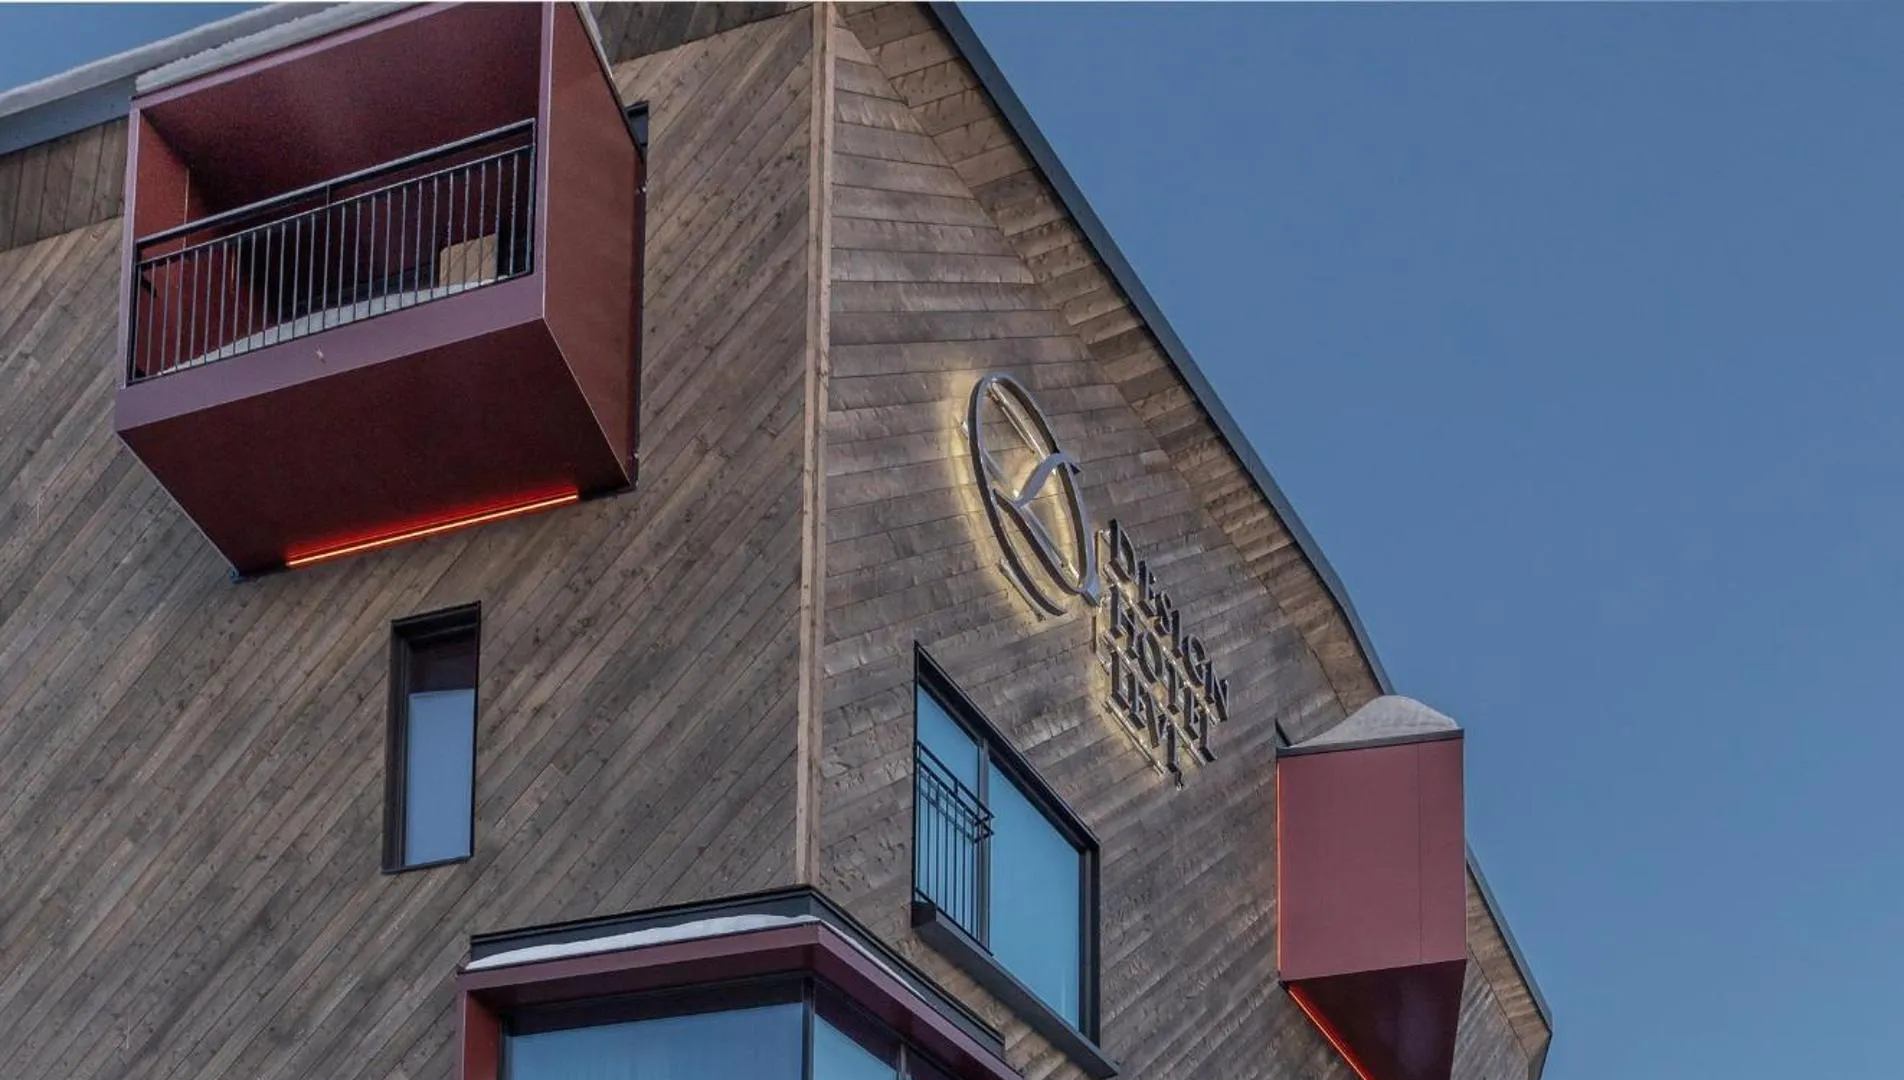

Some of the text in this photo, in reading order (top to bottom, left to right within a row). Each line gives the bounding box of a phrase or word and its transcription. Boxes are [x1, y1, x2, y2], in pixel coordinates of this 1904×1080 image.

[1109, 518, 1230, 721] DESIGN
[1109, 584, 1217, 762] HOTEL
[1110, 651, 1180, 773] LEVI
